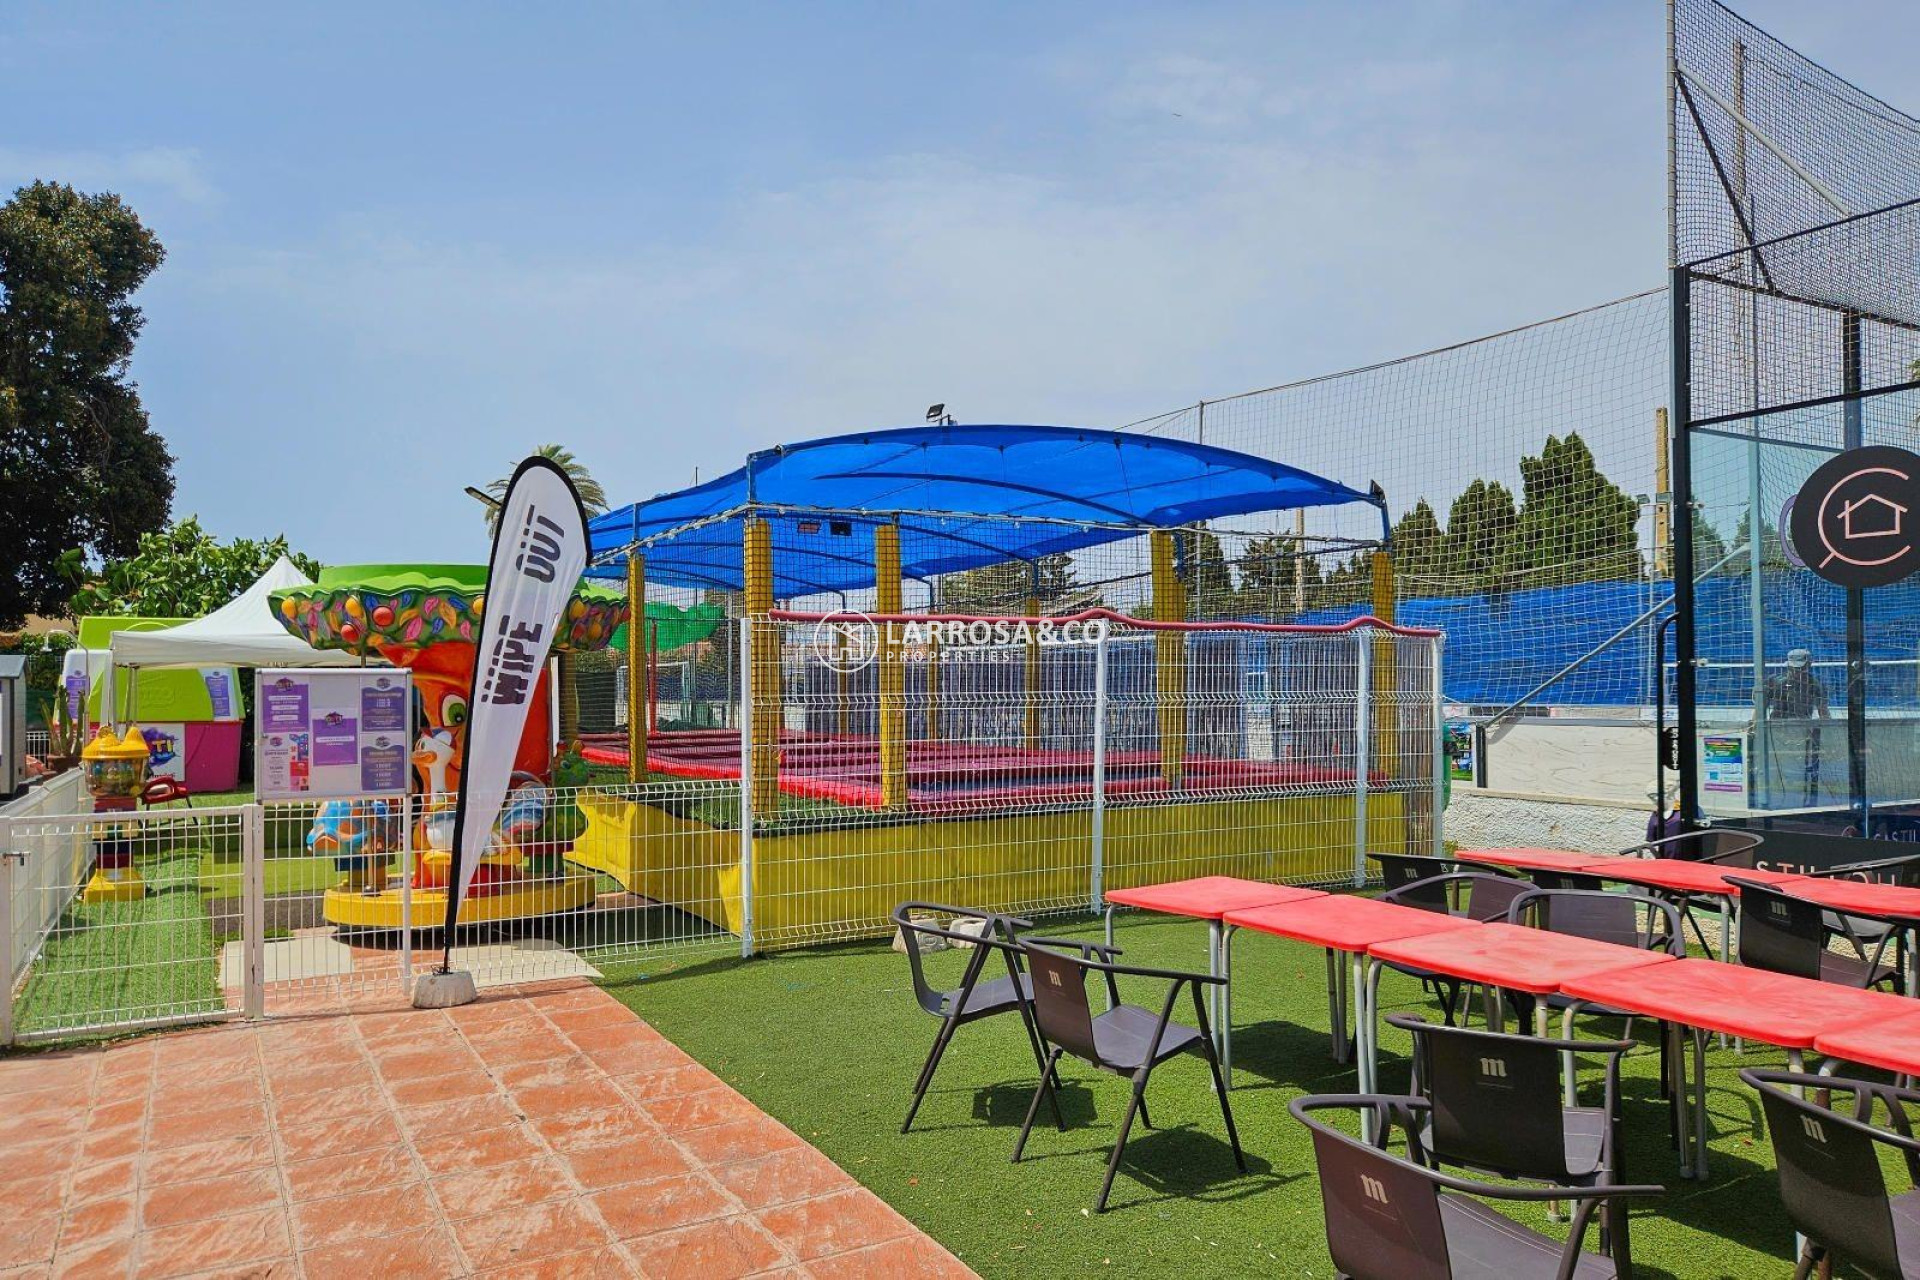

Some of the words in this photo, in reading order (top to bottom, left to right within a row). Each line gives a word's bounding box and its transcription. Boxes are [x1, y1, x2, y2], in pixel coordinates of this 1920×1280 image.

[481, 615, 543, 705] WIPE
[1480, 1057, 1507, 1078] m
[1800, 1115, 1828, 1143] m
[1360, 1172, 1388, 1204] m
